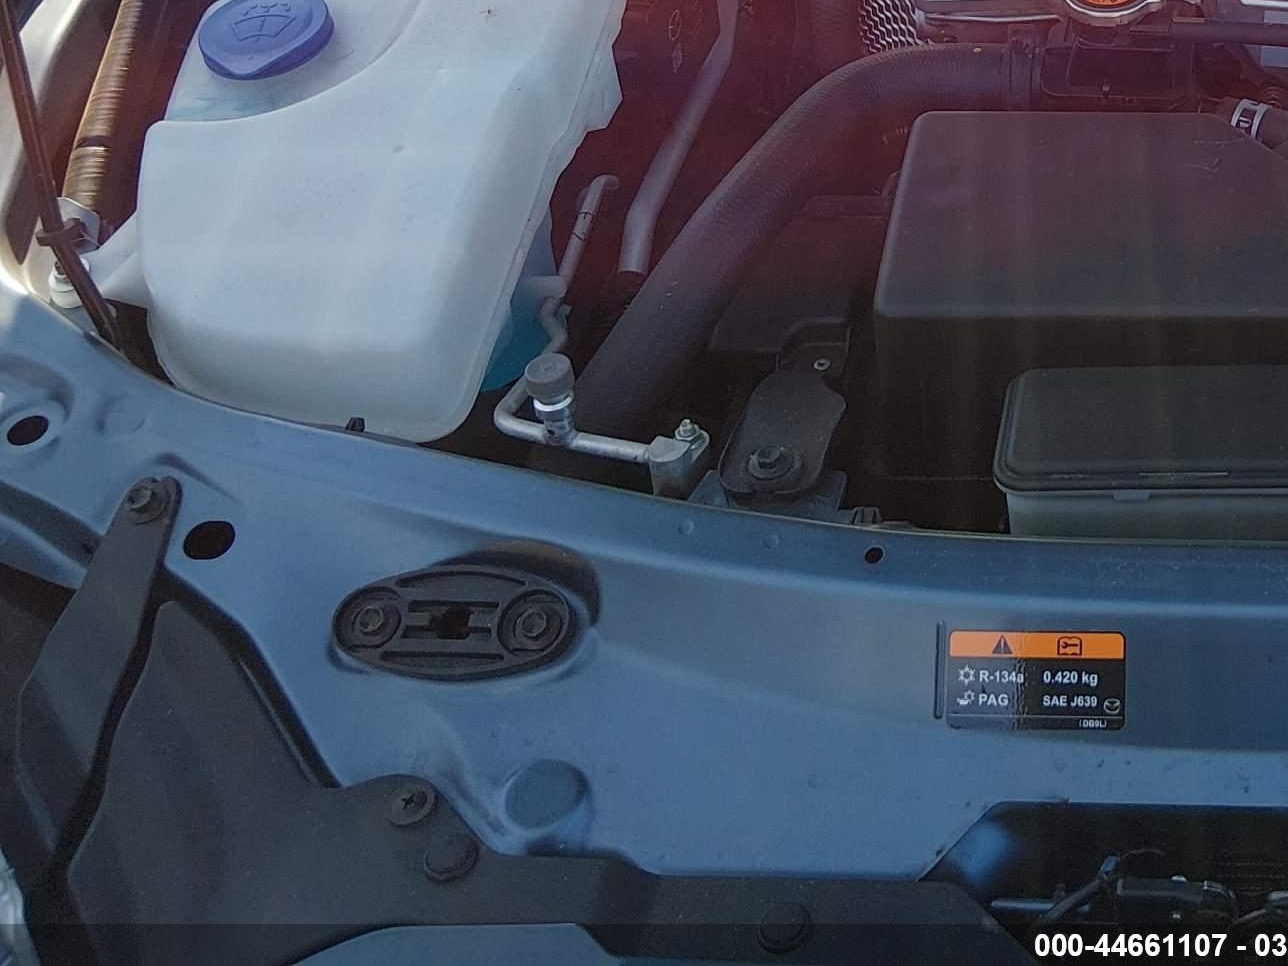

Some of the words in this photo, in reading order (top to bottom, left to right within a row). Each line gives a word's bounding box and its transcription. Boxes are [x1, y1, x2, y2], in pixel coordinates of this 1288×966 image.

[979, 670, 1024, 684] R-134a
[1043, 670, 1078, 684] 0.420
[1081, 671, 1098, 686] kg
[978, 693, 1009, 706] PAG
[1042, 695, 1068, 707] SAE
[1070, 695, 1098, 707] J639
